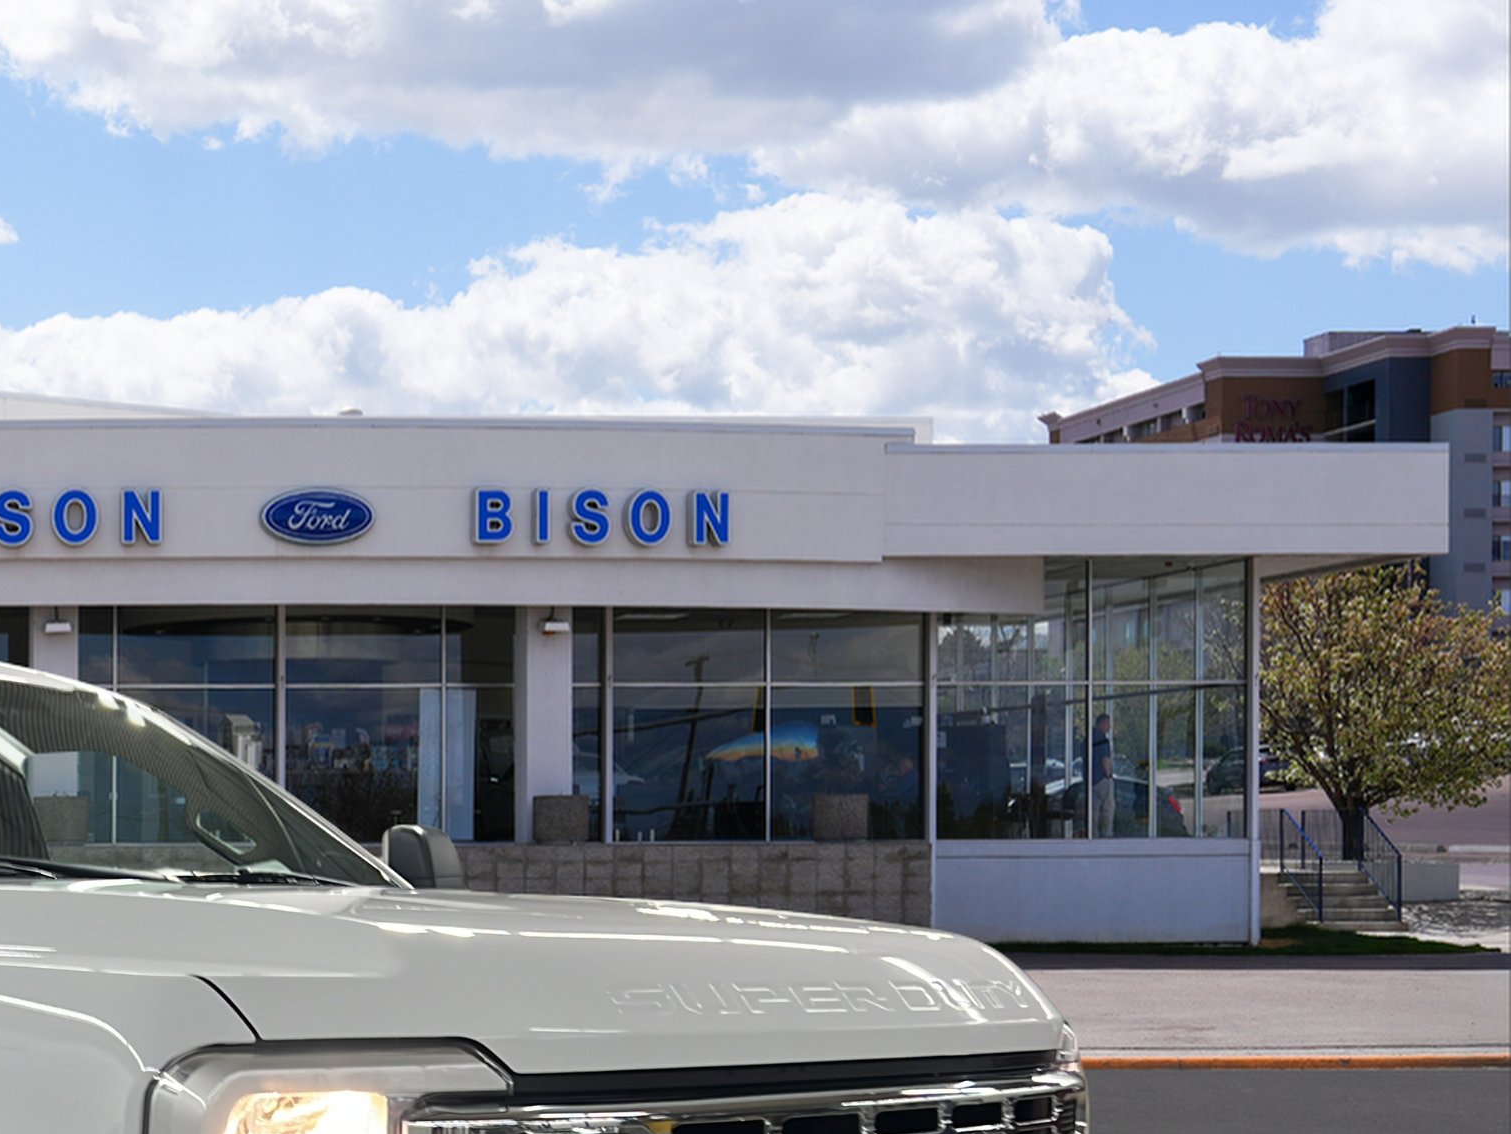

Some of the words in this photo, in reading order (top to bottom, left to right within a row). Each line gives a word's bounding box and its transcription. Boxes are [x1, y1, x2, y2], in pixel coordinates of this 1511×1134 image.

[1241, 393, 1301, 419] TONY
[288, 500, 352, 531] Ford
[474, 487, 731, 545] BISON
[606, 980, 894, 1014] SUPER
